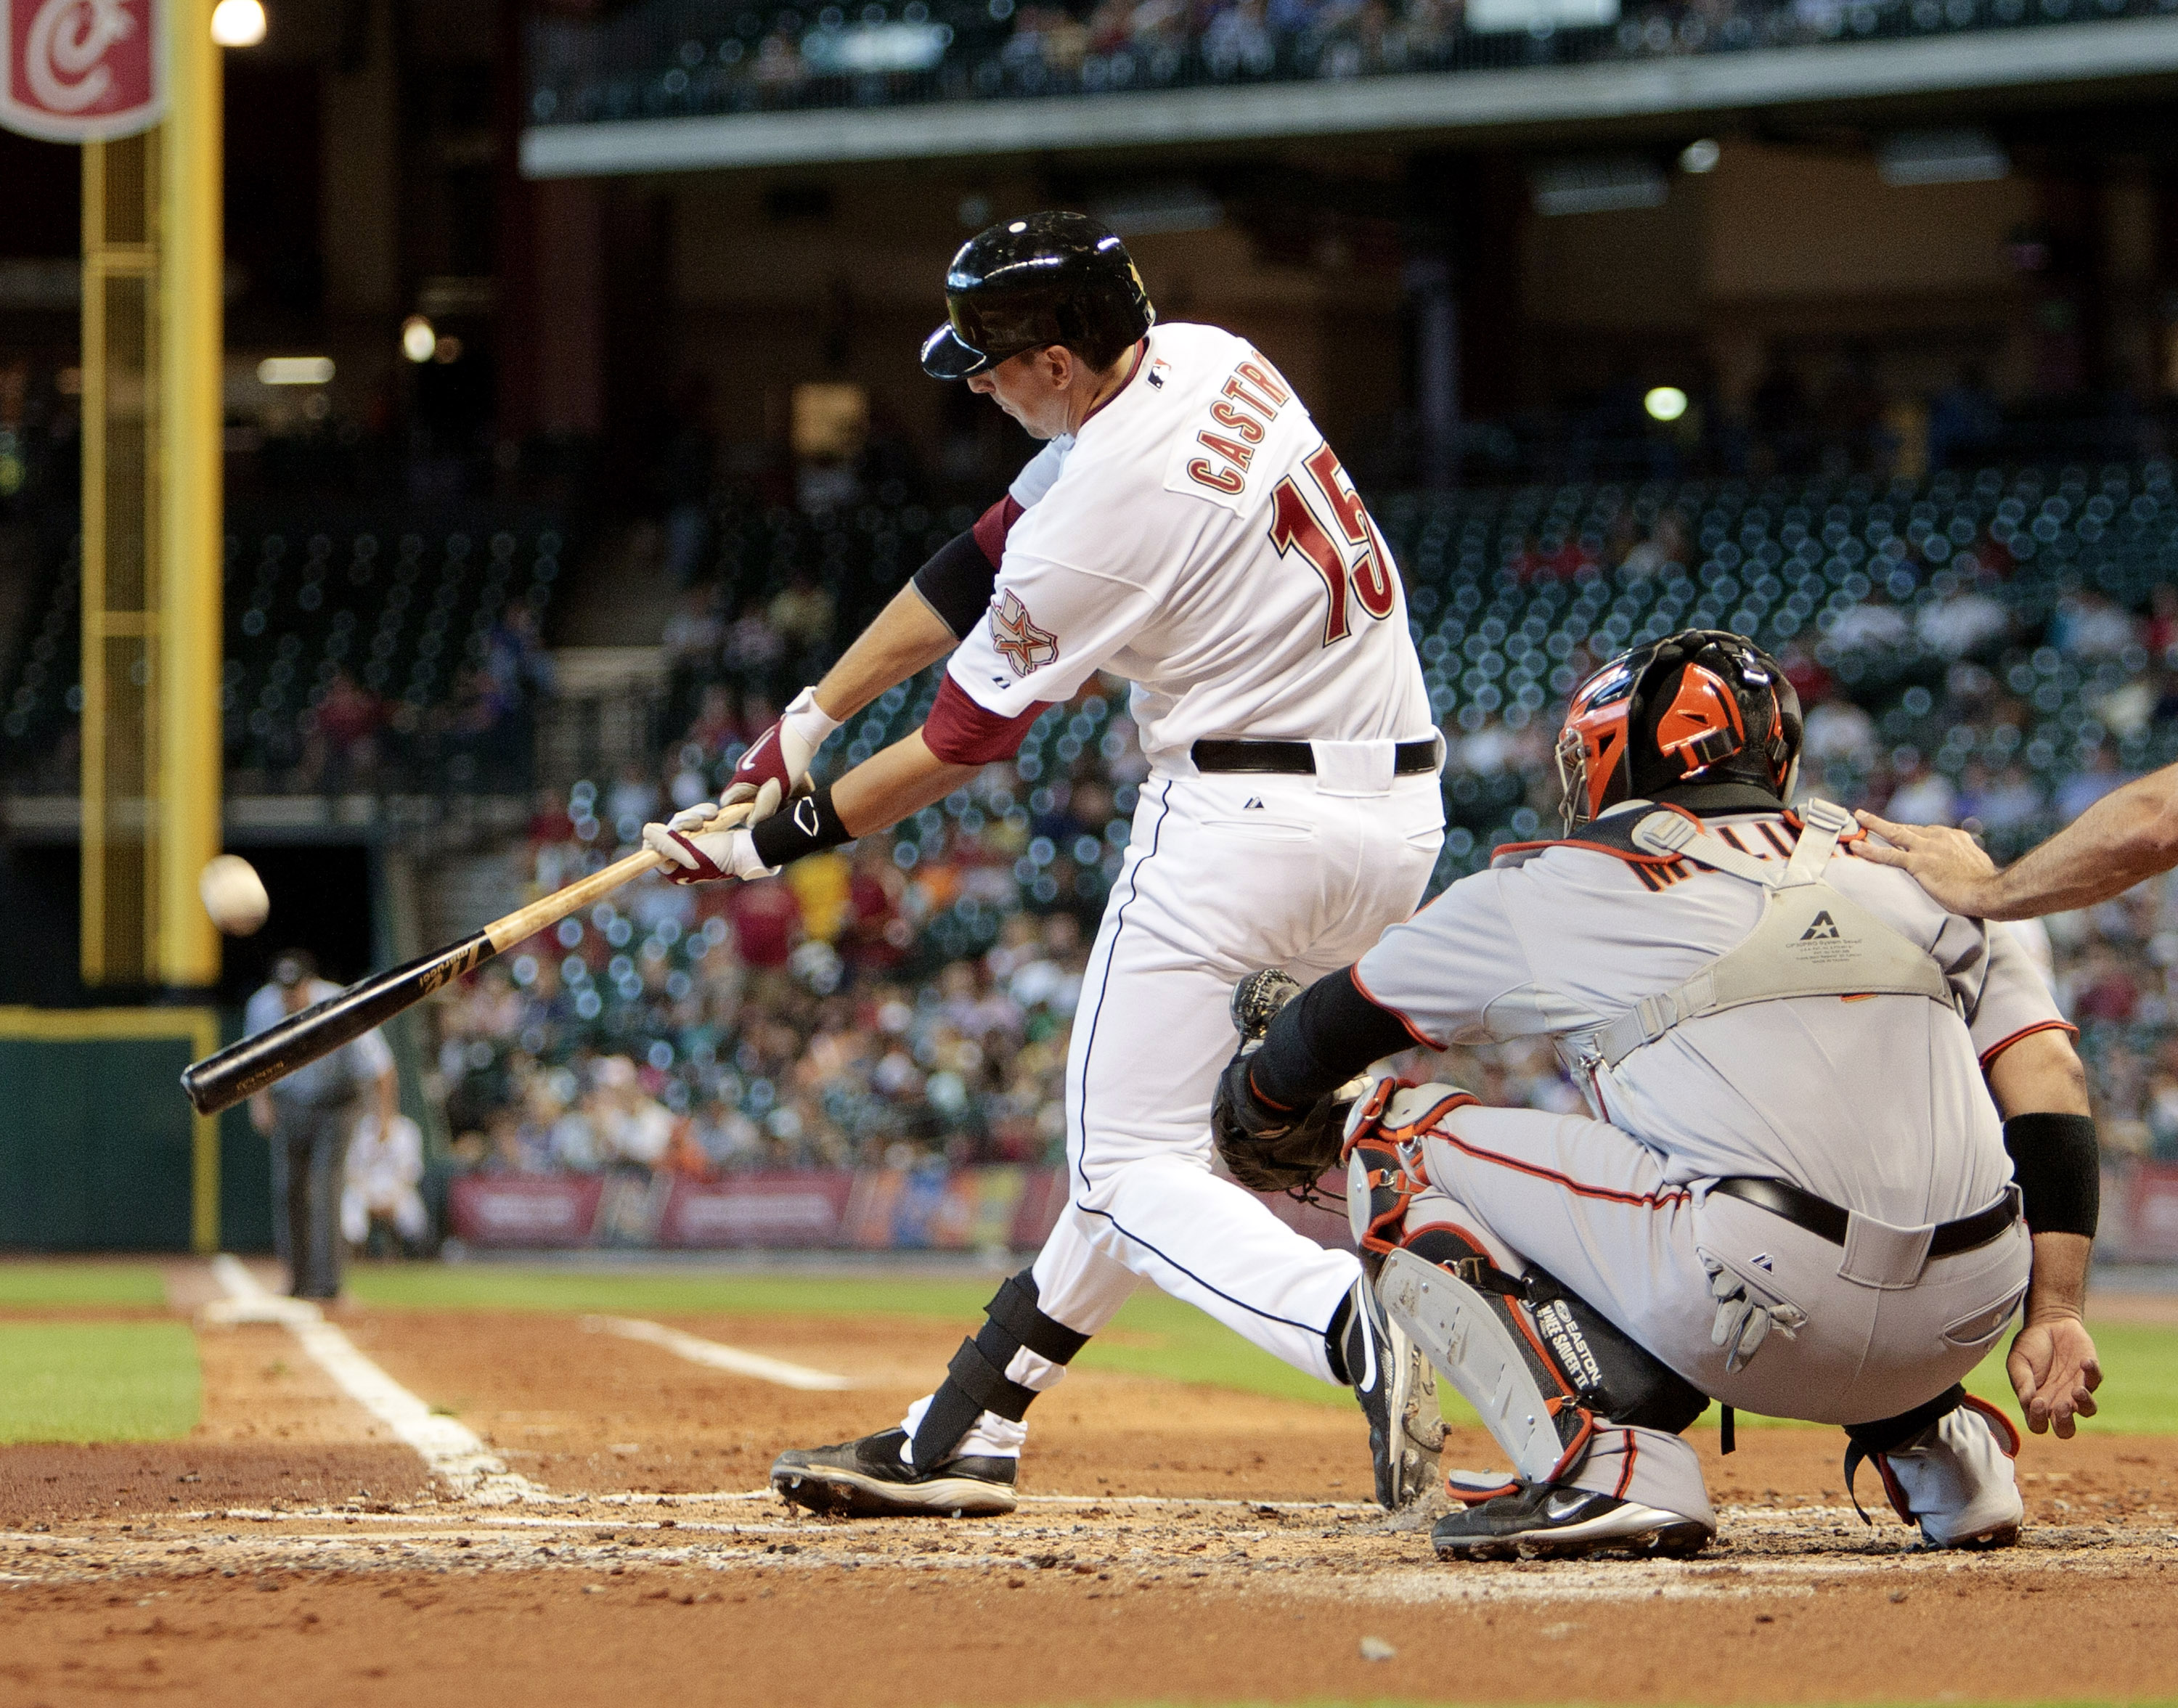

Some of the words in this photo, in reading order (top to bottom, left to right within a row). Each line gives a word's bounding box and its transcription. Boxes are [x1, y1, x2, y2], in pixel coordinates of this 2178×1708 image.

[1268, 440, 1395, 648] 15
[1552, 1333, 1582, 1376] SAVER
[1565, 1320, 1602, 1384] EASTON
